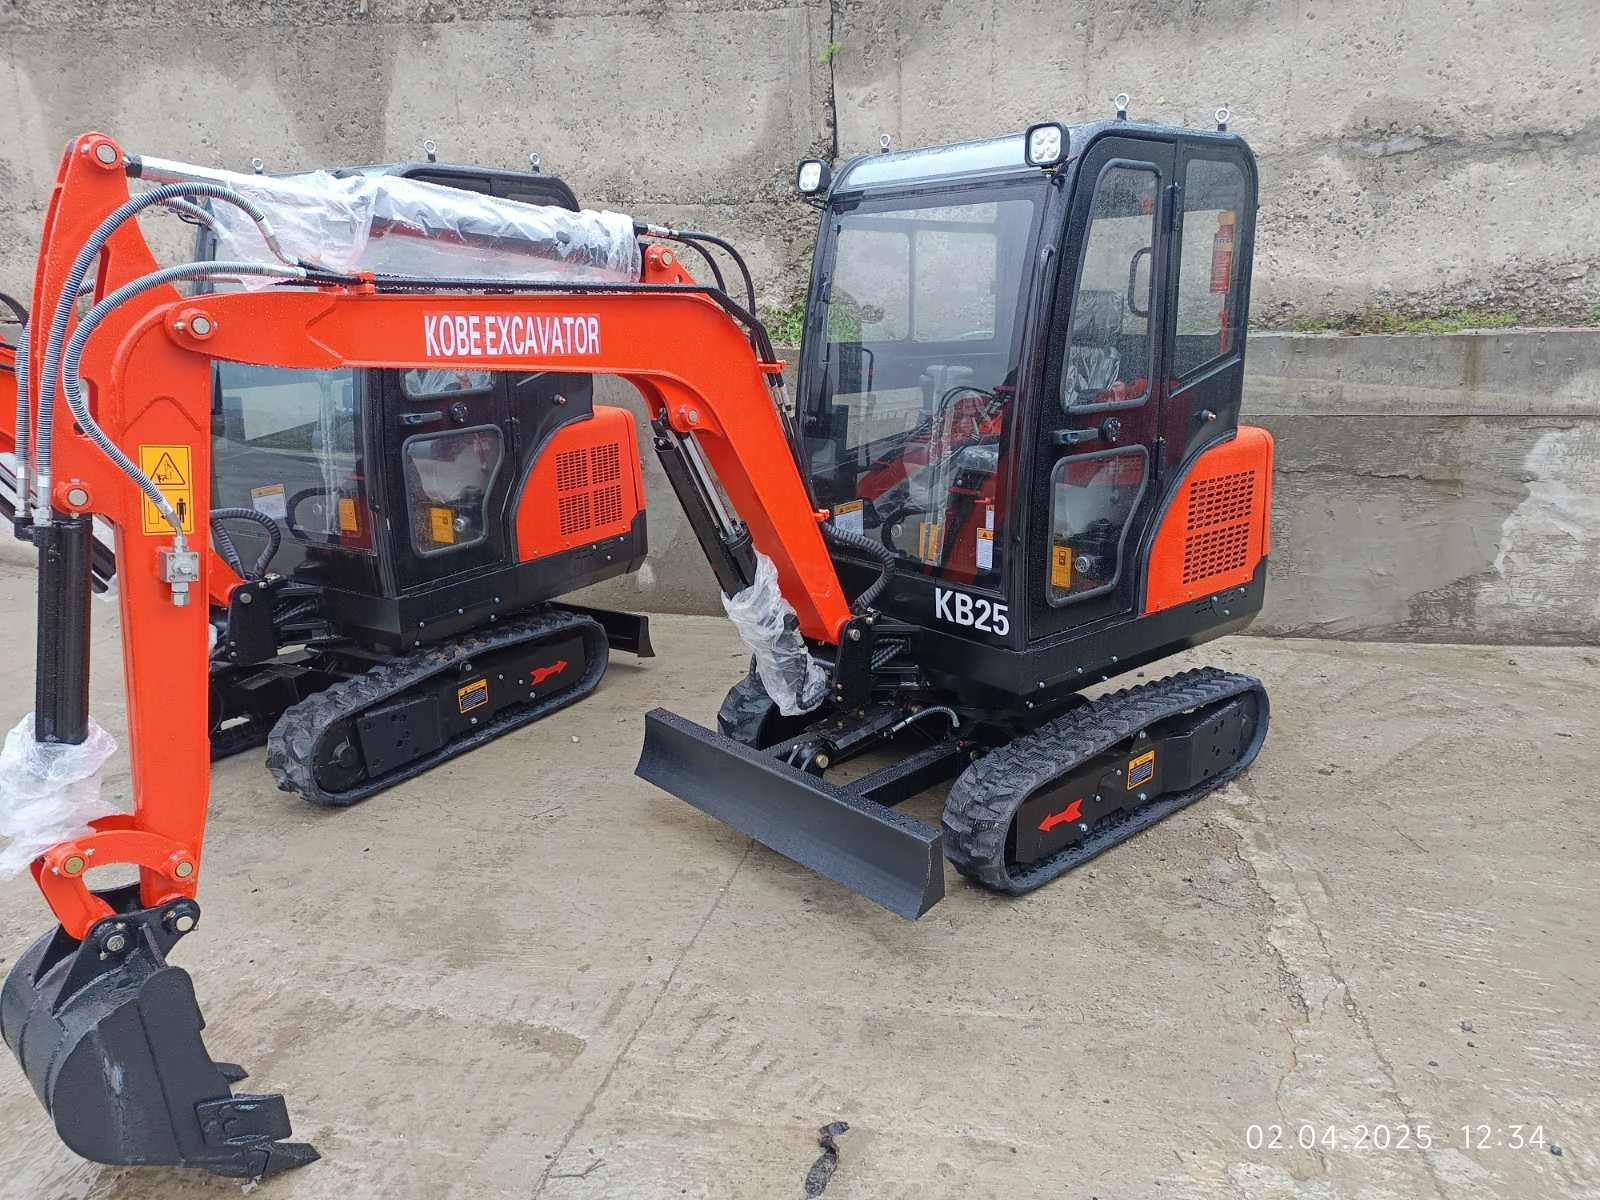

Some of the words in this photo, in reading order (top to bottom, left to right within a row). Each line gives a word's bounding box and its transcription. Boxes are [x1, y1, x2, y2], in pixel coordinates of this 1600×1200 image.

[424, 315, 482, 357] KOBE
[485, 315, 600, 356] EXCAVATOR
[935, 587, 1010, 636] KB25
